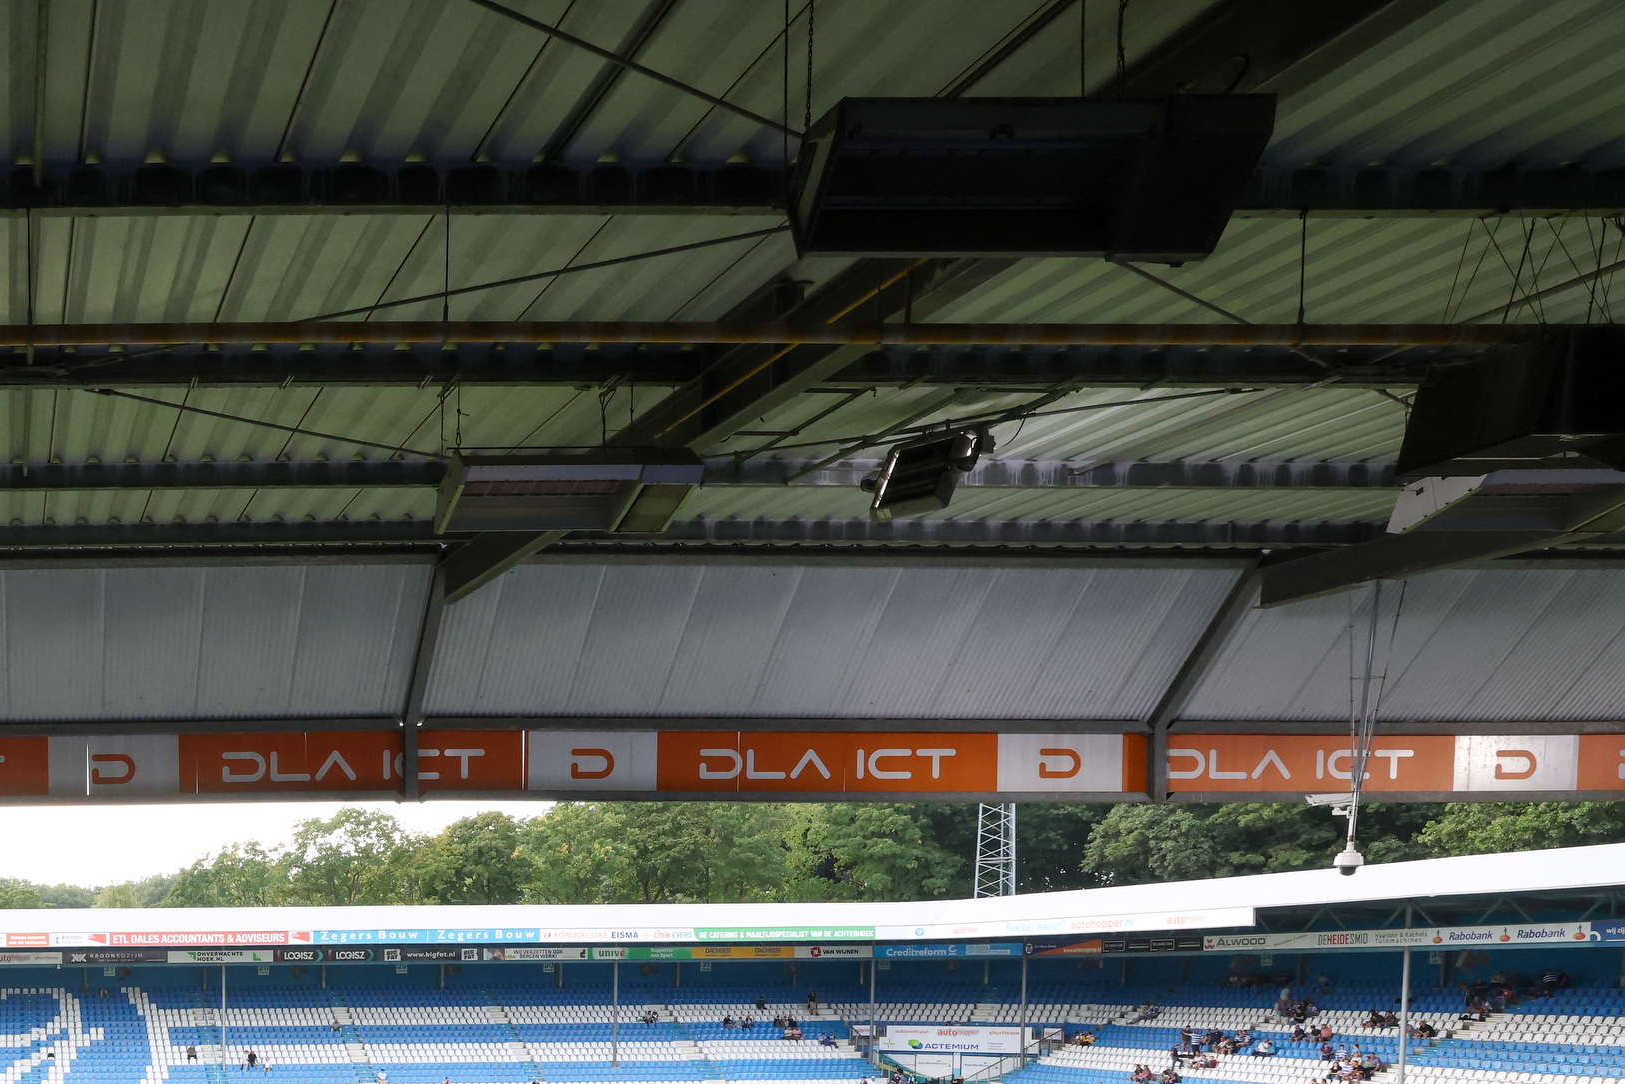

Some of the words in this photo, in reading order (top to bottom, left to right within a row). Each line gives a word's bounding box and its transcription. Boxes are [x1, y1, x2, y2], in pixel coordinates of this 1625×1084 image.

[91, 754, 137, 785] D
[222, 751, 357, 783] DLA
[382, 748, 486, 780] ICT
[570, 748, 615, 779] D
[699, 748, 832, 779] DLA
[856, 748, 957, 779] ICT
[1038, 748, 1082, 779] D
[1168, 748, 1292, 780] DLA
[1316, 749, 1415, 779] ICT
[1495, 749, 1537, 779] D
[1006, 922, 1034, 932] flexibel
[1036, 920, 1066, 931] leasen?
[1071, 917, 1135, 930] autohopper.nl
[320, 931, 371, 942] Zegers
[378, 930, 419, 939] Bouw
[437, 930, 489, 941] Zegers
[495, 929, 535, 939] Bouw
[834, 929, 874, 937] ACHTERHOEK
[1449, 931, 1493, 941] Rabobank
[1517, 929, 1565, 939] Rabobank
[1606, 927, 1616, 935] wij
[113, 935, 128, 944] ETL
[131, 935, 159, 944] DALES
[161, 934, 224, 943] ACCOUNTANTS
[227, 934, 233, 942] &
[235, 933, 285, 942] ADVISEURS
[1216, 937, 1266, 946] ALWOOD
[1318, 933, 1368, 946] DEHEIDESMID
[284, 952, 313, 960] LOGISZ
[335, 951, 365, 959] LOGISZ
[598, 948, 625, 957] univé
[886, 948, 946, 957] Creditreform
